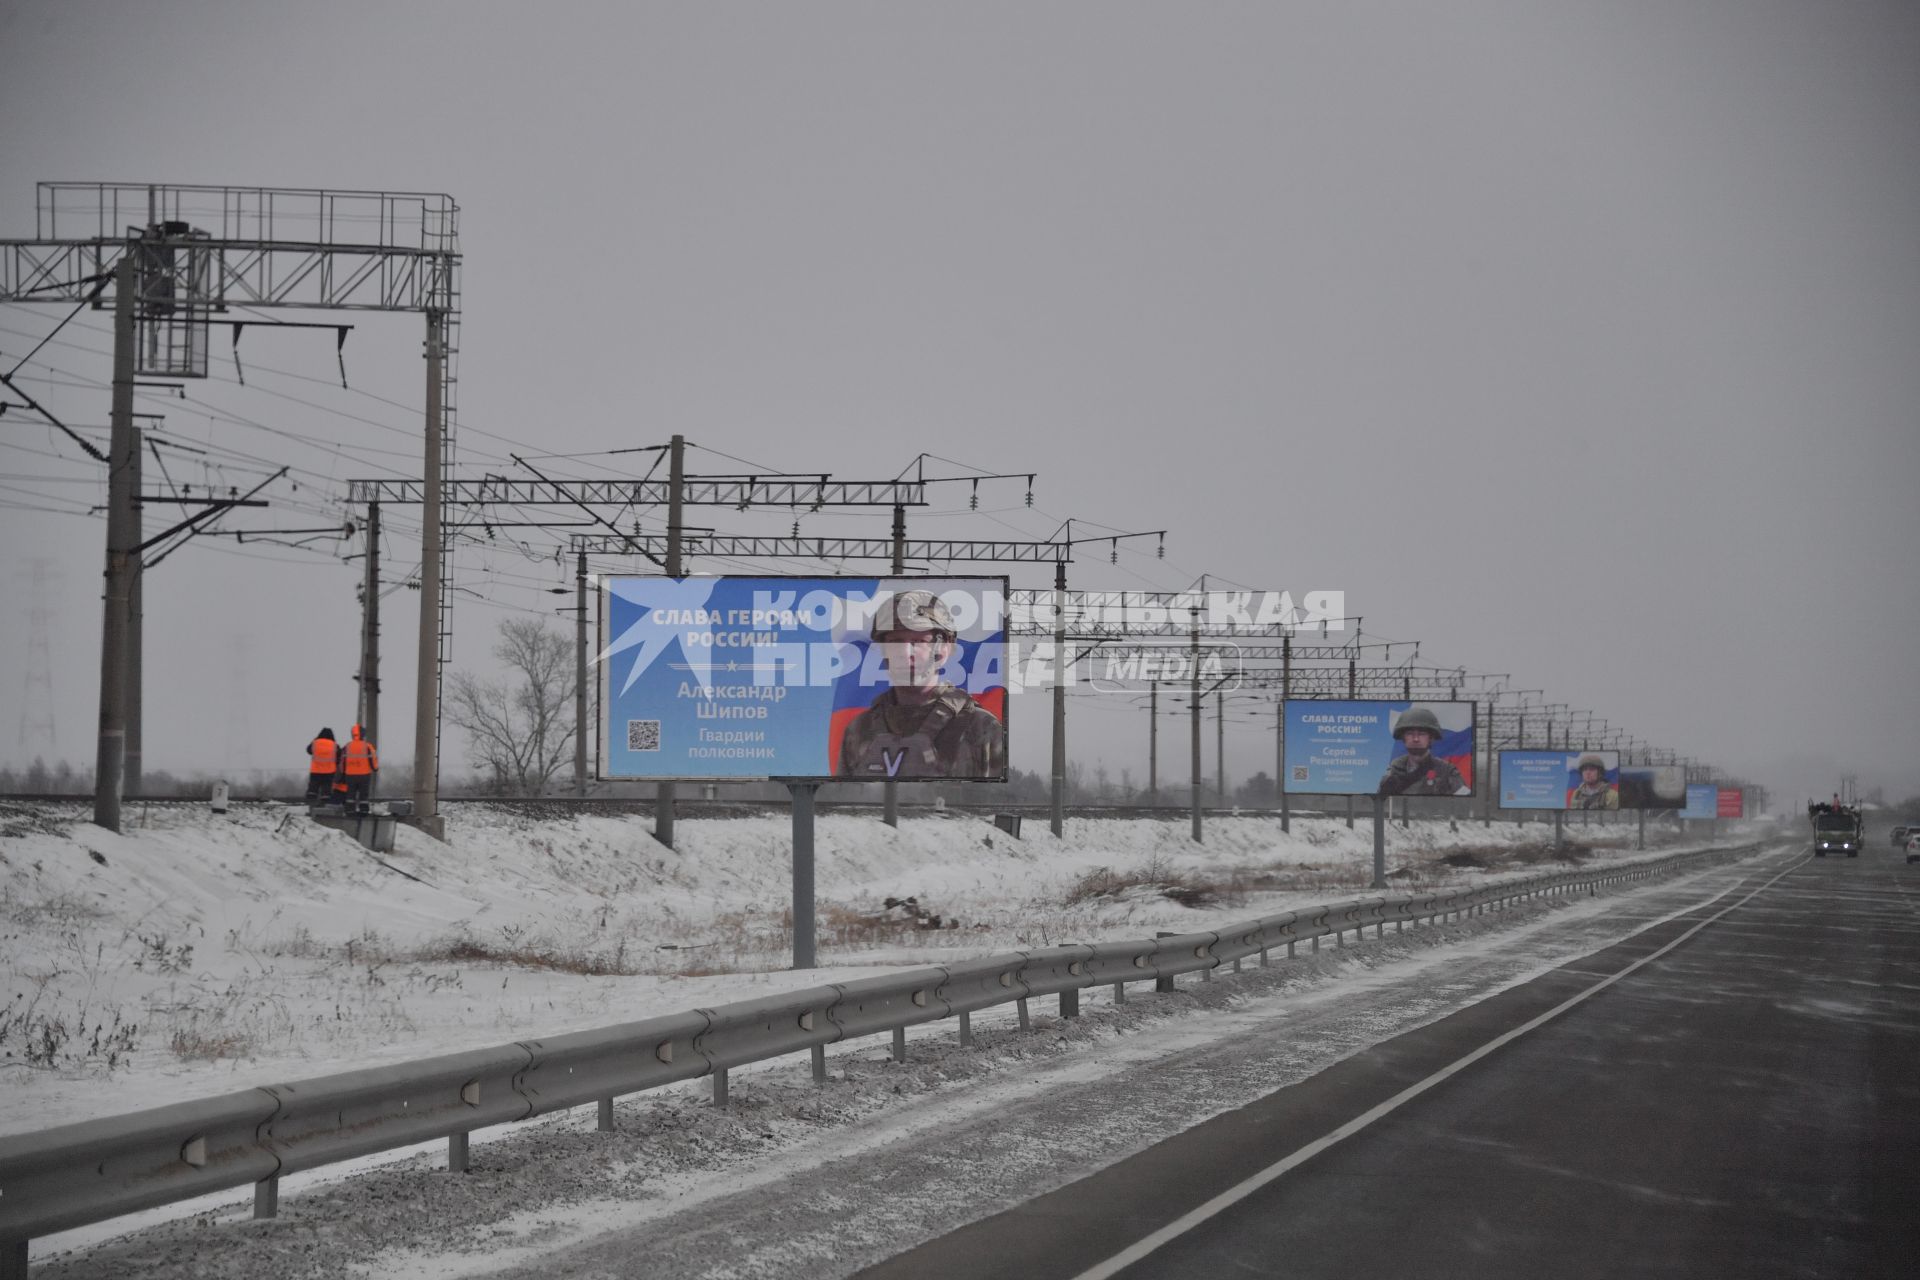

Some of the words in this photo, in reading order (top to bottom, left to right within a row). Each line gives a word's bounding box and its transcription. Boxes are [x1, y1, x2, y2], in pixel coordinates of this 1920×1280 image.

[652, 609, 722, 625] СЛАВА
[728, 609, 811, 626] ГЕРОЯМ
[686, 631, 778, 648] РОССИИ!
[677, 681, 787, 702] Александр
[696, 702, 768, 720] Шипов
[1302, 714, 1335, 723] СЛАВА
[1338, 715, 1377, 723] ГЕРОЯМ
[698, 727, 765, 745] Гвардии
[1318, 725, 1361, 733] РОССИИ!
[688, 746, 776, 760] полковник
